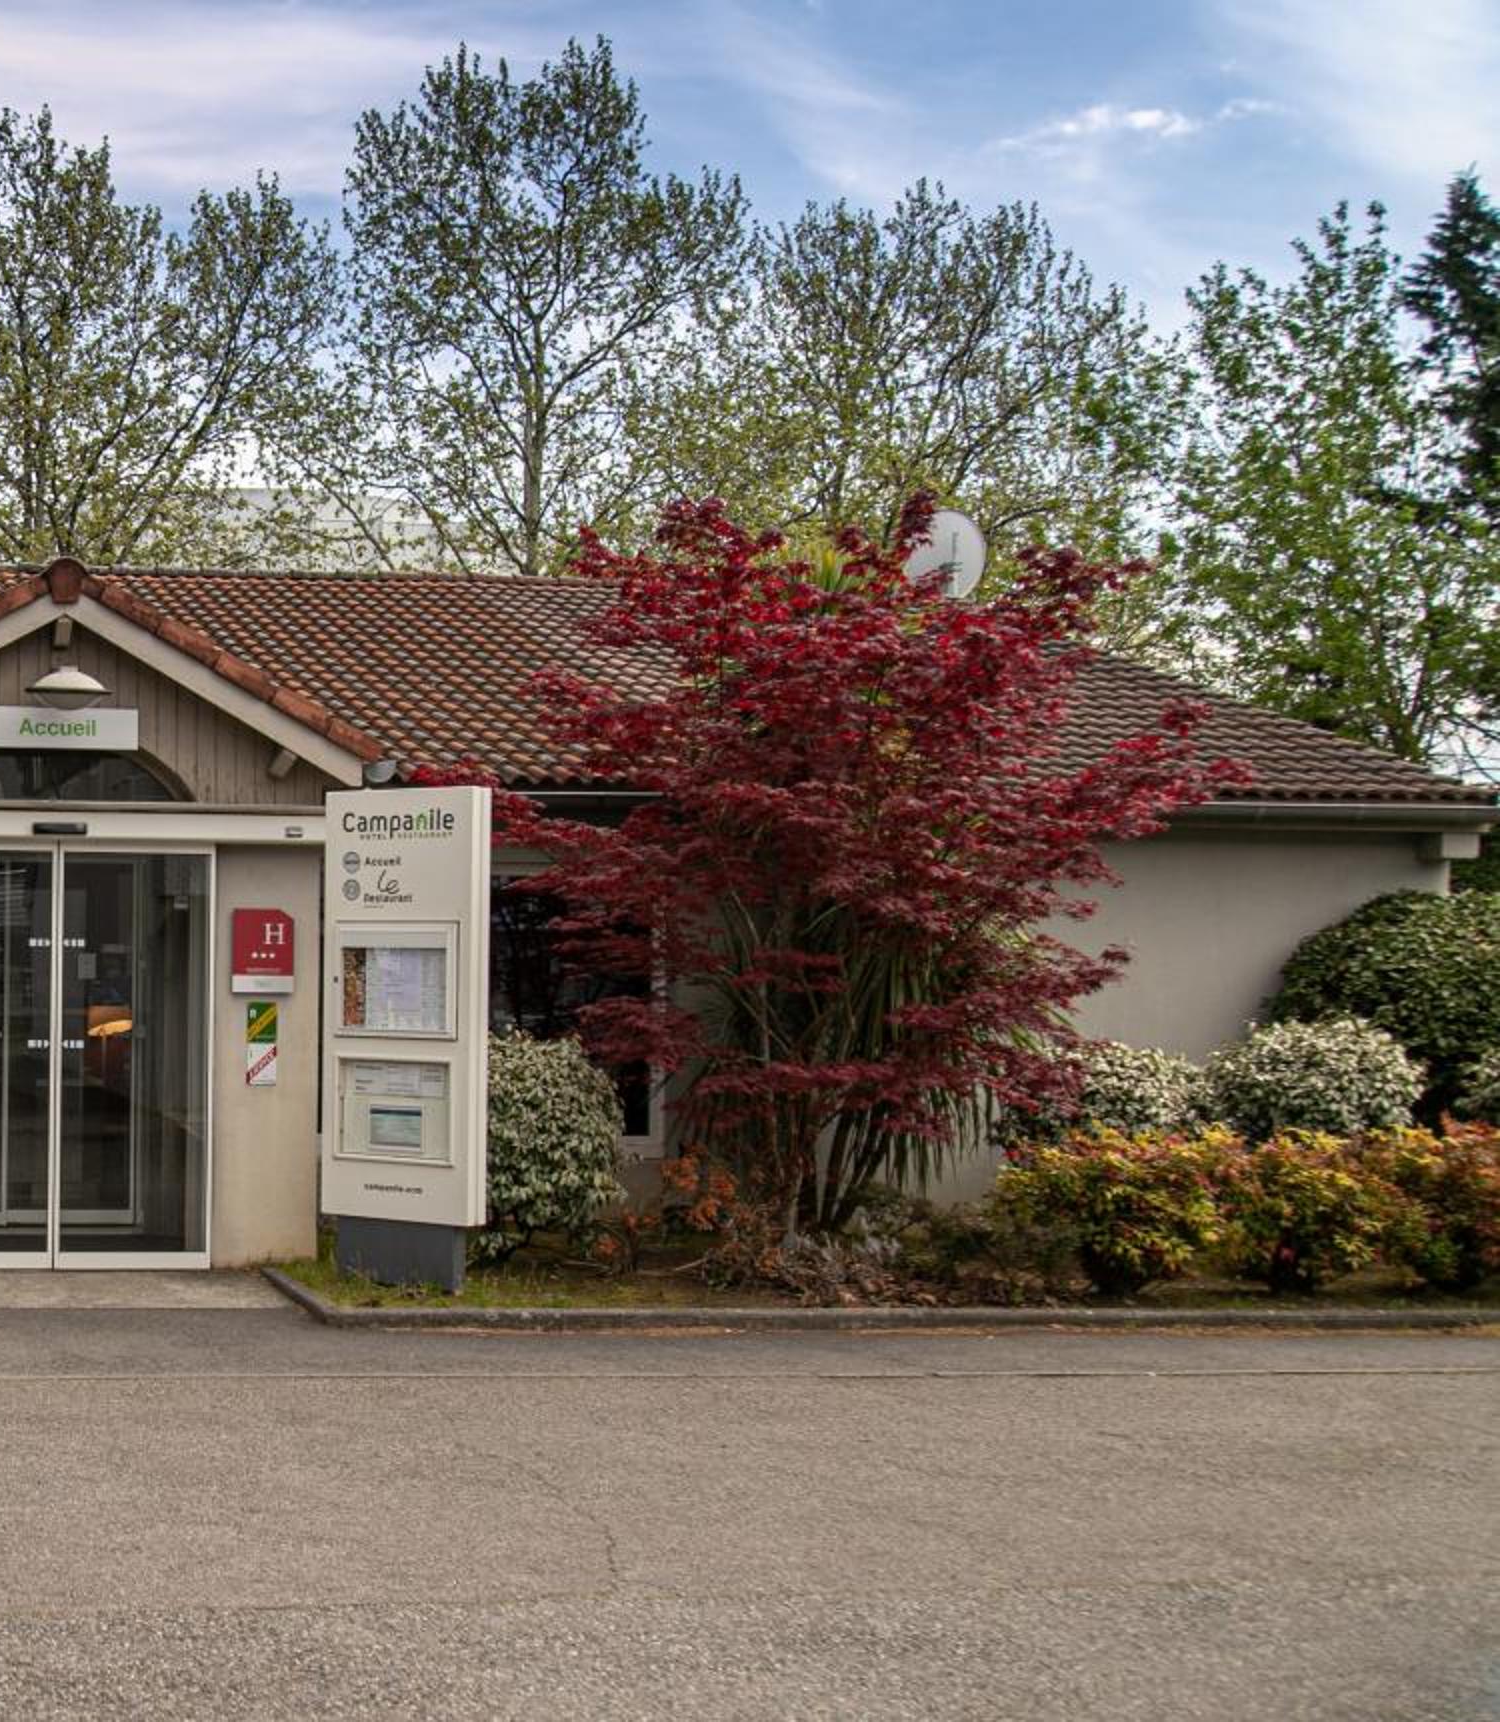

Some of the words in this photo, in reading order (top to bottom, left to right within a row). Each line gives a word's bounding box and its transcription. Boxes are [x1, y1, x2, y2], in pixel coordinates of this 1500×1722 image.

[19, 718, 97, 737] Accueil
[343, 808, 454, 839] Campanile
[365, 856, 401, 866] Accueil
[263, 922, 286, 945] H
